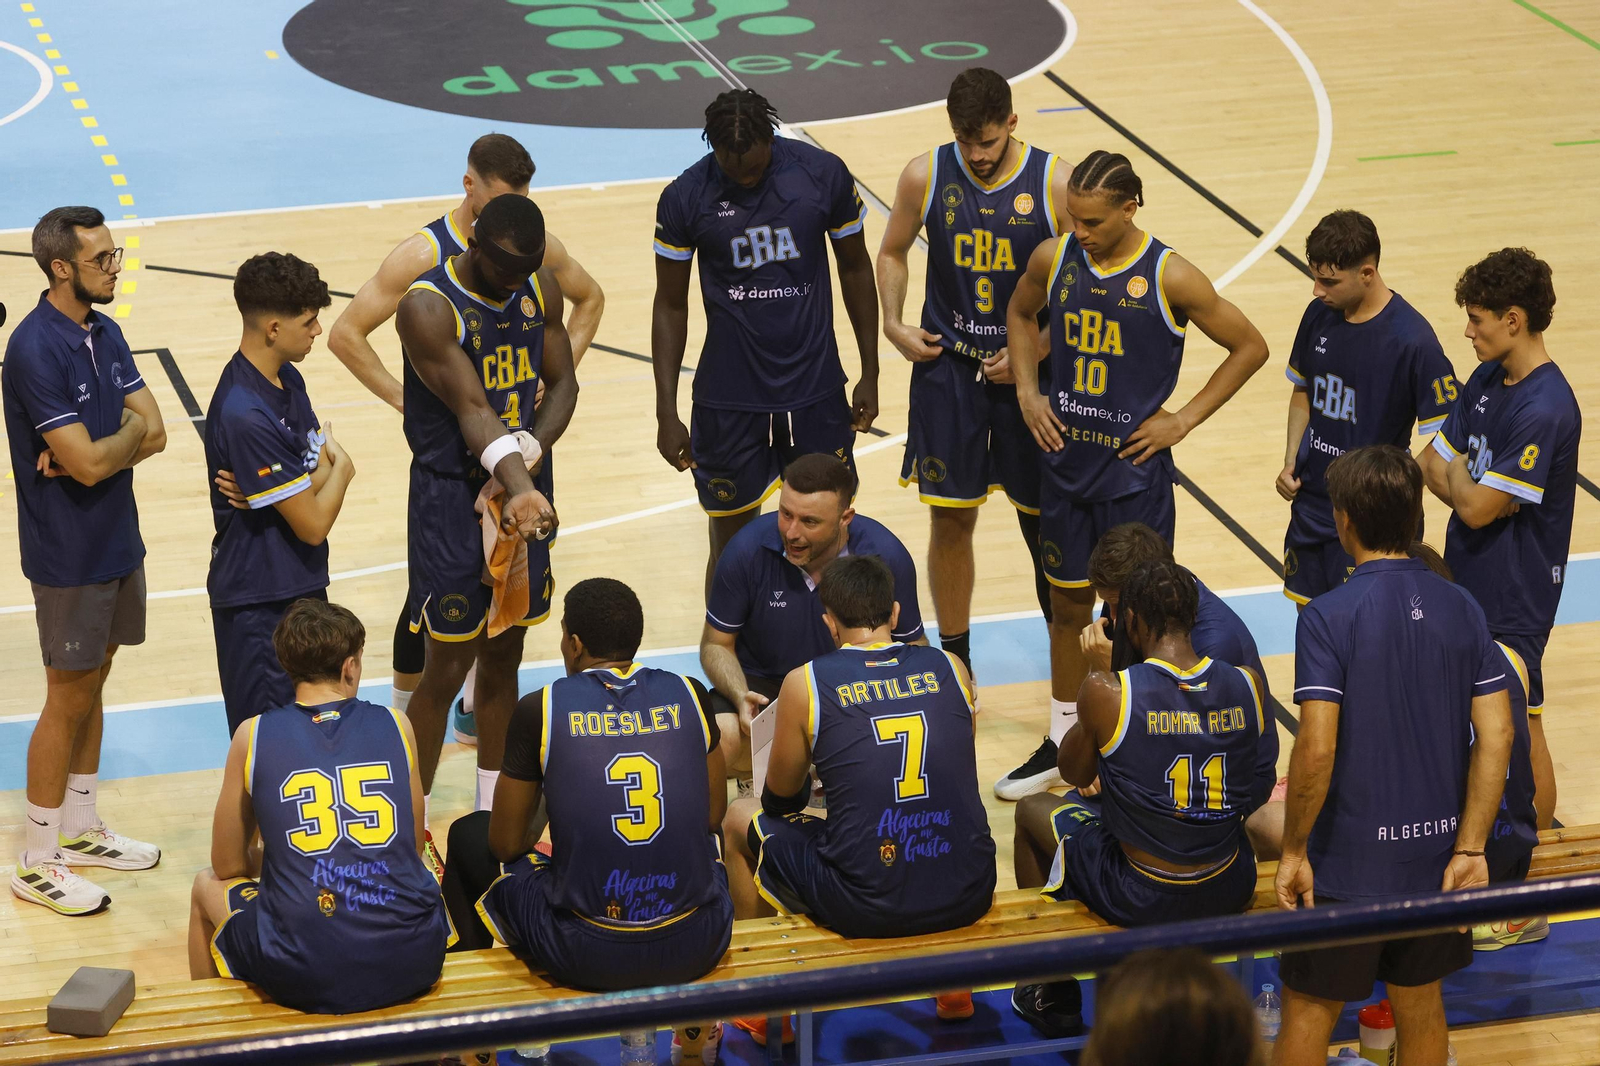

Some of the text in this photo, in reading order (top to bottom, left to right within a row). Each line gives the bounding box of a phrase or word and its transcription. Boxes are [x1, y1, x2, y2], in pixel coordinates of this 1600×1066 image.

[443, 38, 988, 96] damex.io
[717, 209, 735, 217] vive
[730, 225, 801, 269] CBA
[954, 228, 1017, 272] CBA
[975, 276, 995, 314] 9
[1091, 287, 1108, 295] vive
[1063, 308, 1124, 356] CBA
[1315, 345, 1327, 354] vive
[482, 344, 537, 391] CBA
[954, 341, 998, 360] ALGEC
[1073, 355, 1109, 397] 10
[1431, 374, 1458, 406] 15
[78, 393, 91, 402] vive
[500, 390, 523, 430] 4
[1069, 399, 1132, 424] damex.io
[1312, 373, 1357, 425] CBA
[1518, 443, 1541, 472] 8
[769, 600, 787, 608] vive
[1411, 608, 1424, 620] CBA
[836, 671, 940, 707] ARTILES
[1147, 706, 1246, 735] ROMAR REID
[870, 710, 930, 803] 7
[604, 751, 666, 846] 3
[1165, 752, 1232, 810] 11
[279, 761, 398, 857] 35
[876, 808, 952, 844] Algeciras
[1378, 815, 1460, 841] ALGECIRA
[905, 834, 952, 862] Gusta
[310, 858, 390, 892] Algeciras
[603, 869, 679, 907] Algeciras
[345, 883, 397, 912] Gusta
[628, 897, 674, 922] Gusta
